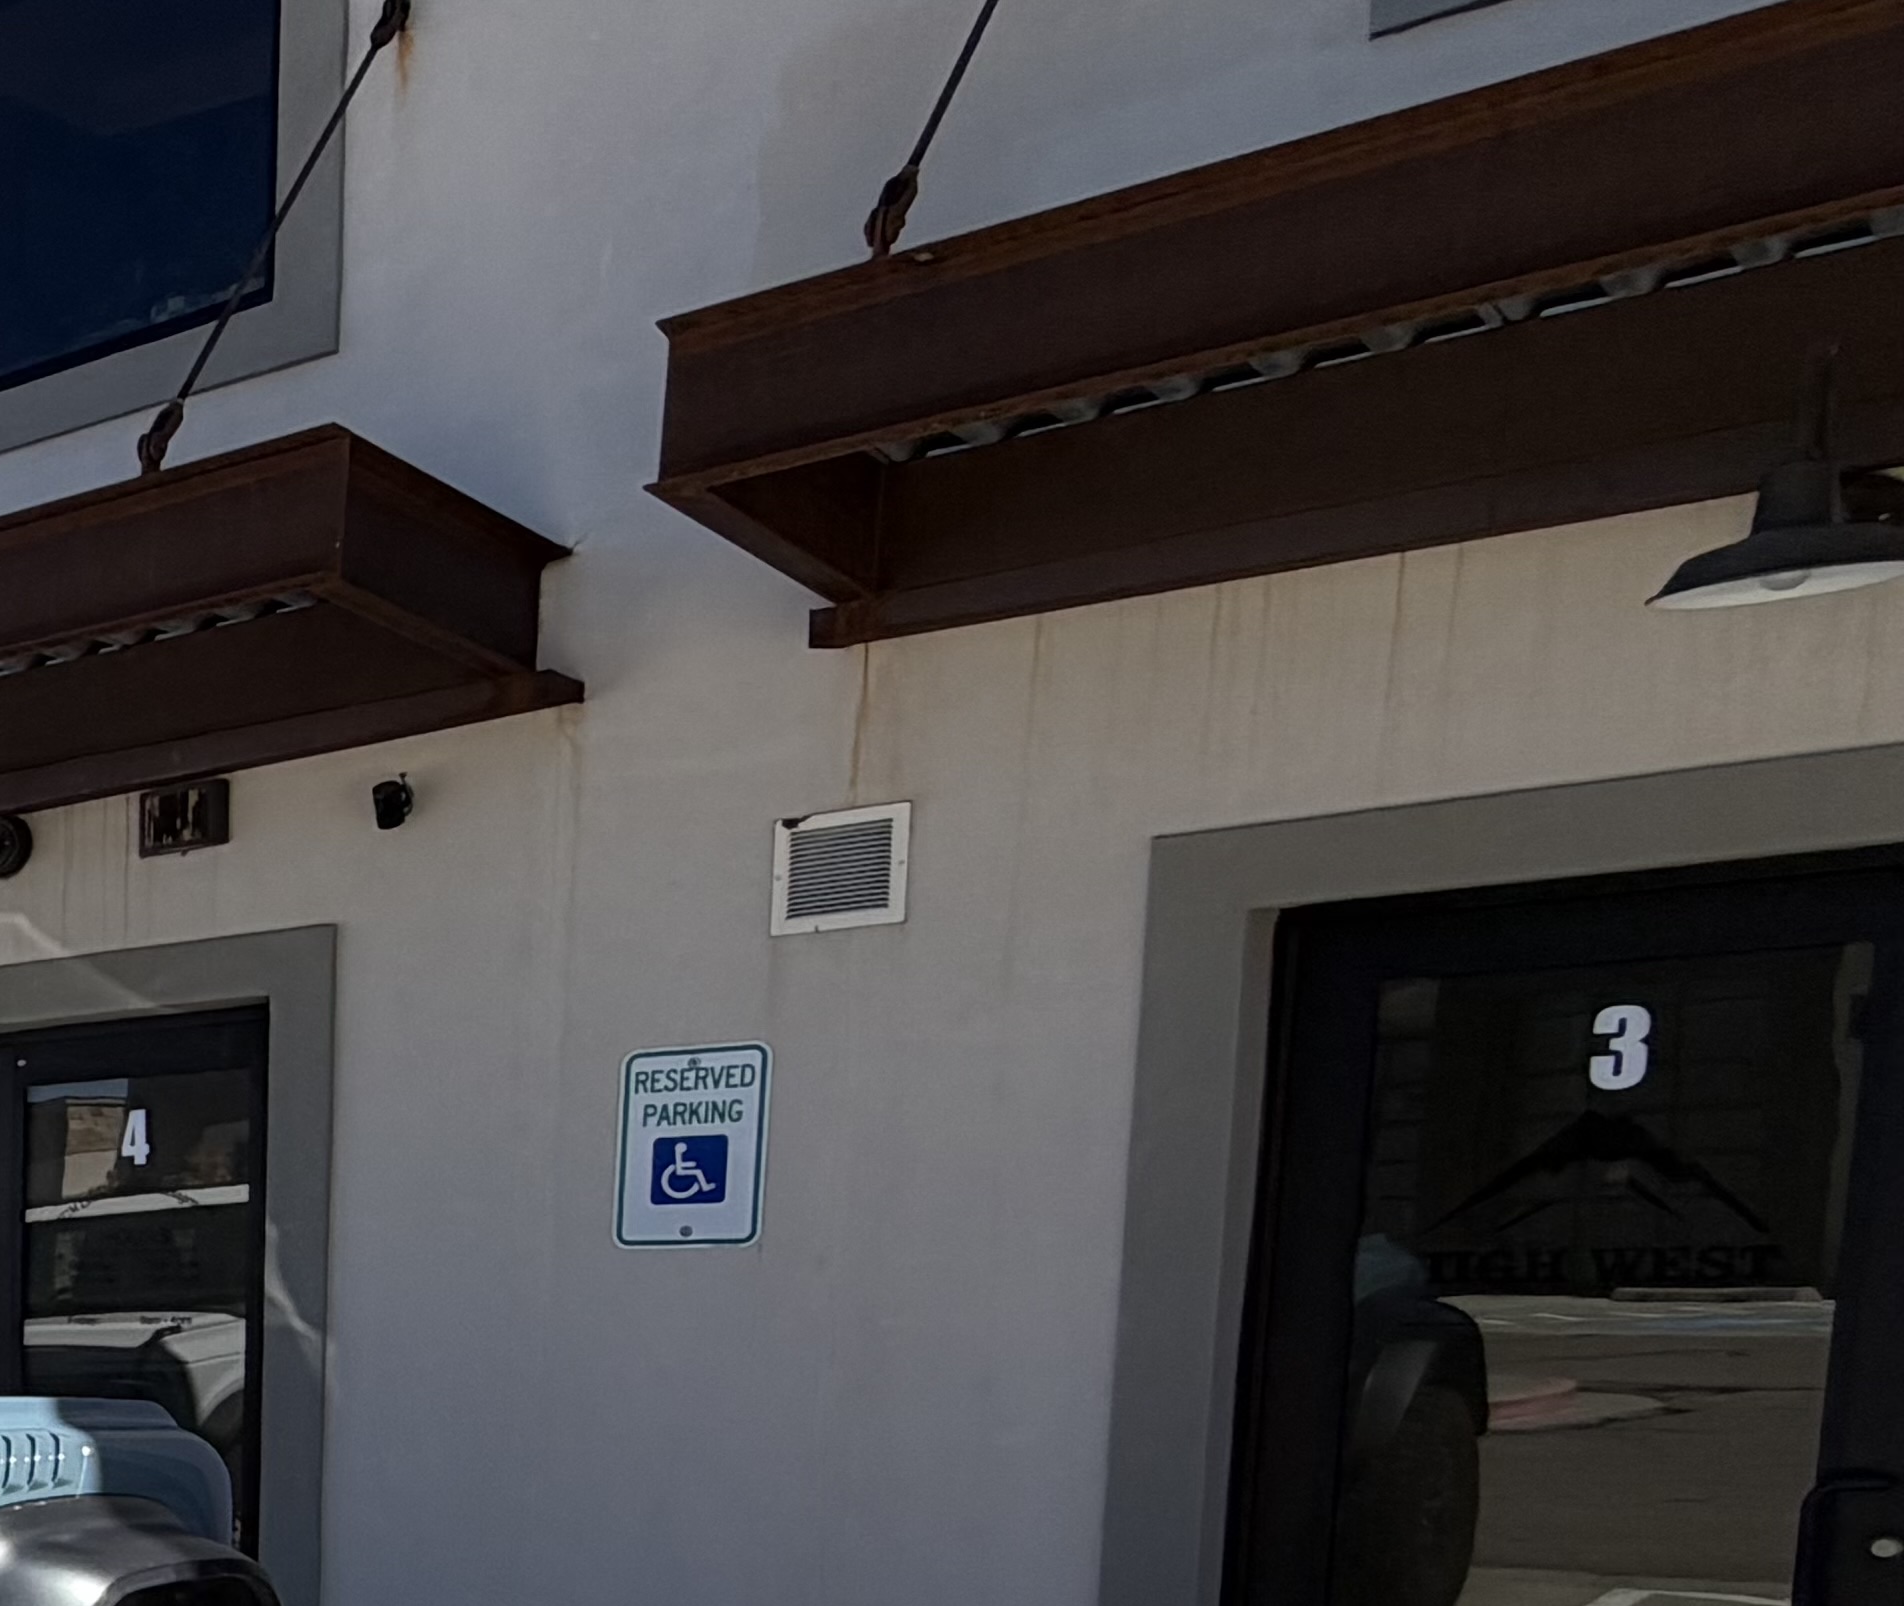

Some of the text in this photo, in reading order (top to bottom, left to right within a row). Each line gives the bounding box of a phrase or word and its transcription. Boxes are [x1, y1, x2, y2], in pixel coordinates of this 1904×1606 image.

[1589, 1004, 1651, 1091] 3
[634, 1063, 756, 1095] RESERVED
[642, 1098, 744, 1128] PARKING
[121, 1108, 150, 1165] 4
[1591, 1243, 1783, 1284] WEST
